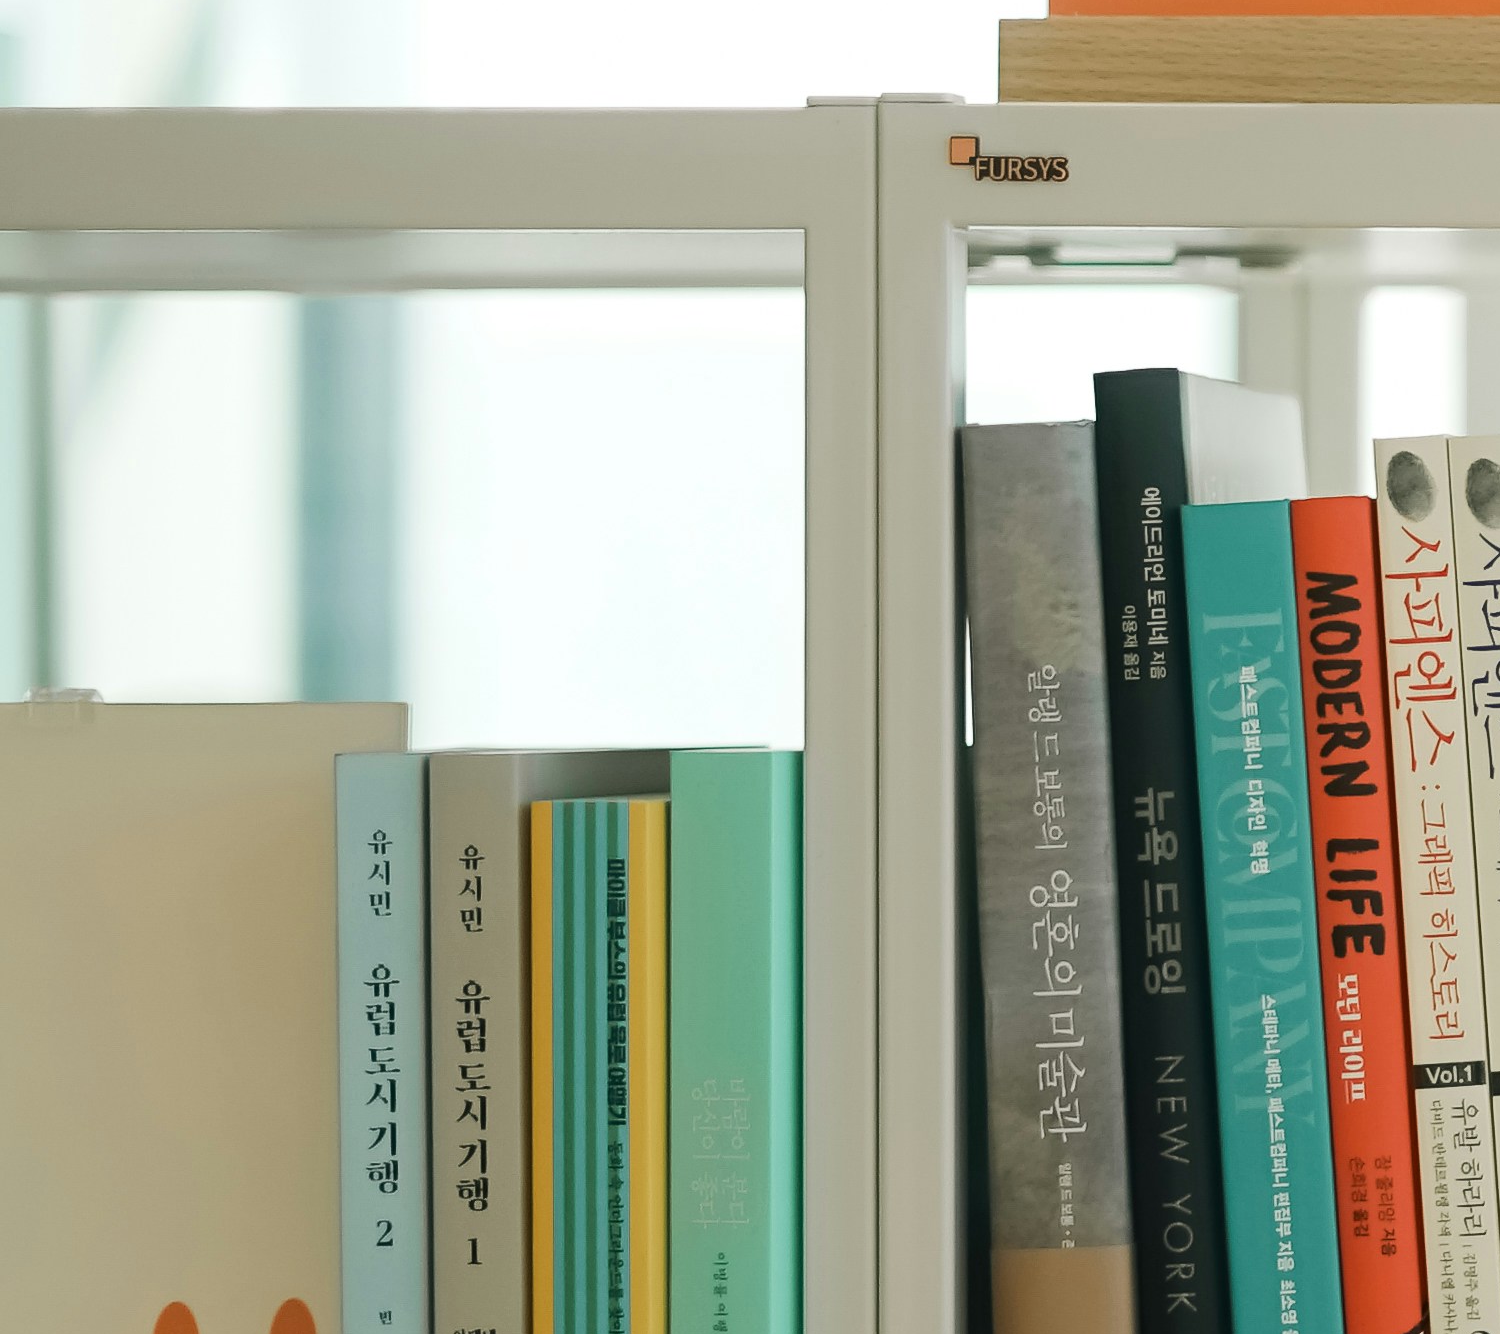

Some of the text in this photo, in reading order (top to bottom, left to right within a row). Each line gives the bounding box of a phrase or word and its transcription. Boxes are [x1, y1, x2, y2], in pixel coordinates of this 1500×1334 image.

[975, 157, 1068, 181] FURSYS
[1139, 487, 1170, 680] 에이드리언 토미네 지음
[1237, 666, 1271, 876] 패스트컴퍼니 디자인 혁명
[1305, 570, 1387, 960] MODERN LIFE
[1385, 525, 1466, 1041] 사피엔스 그래픽 히스토리
[367, 828, 393, 917] 유시민
[458, 843, 486, 933] 유시민
[607, 858, 626, 918] 마이클
[1026, 664, 1087, 1142] 알랭 드 보통의 영혼의 미술관
[1134, 787, 1186, 996] 뉴욕 드로잉
[607, 921, 626, 980] 부스의
[607, 983, 626, 1023] 유럽
[607, 1067, 626, 1126] 여행기
[1335, 972, 1367, 1105] 모던 라이프
[1424, 1064, 1475, 1086] Vol.1
[363, 963, 401, 1247] 유럽 도시 기행 2
[456, 979, 491, 1265] 유럽 도시 기행 1
[1154, 1055, 1190, 1165] NEW
[1452, 1097, 1488, 1239] 유발 하라리
[1160, 1194, 1197, 1314] YORK
